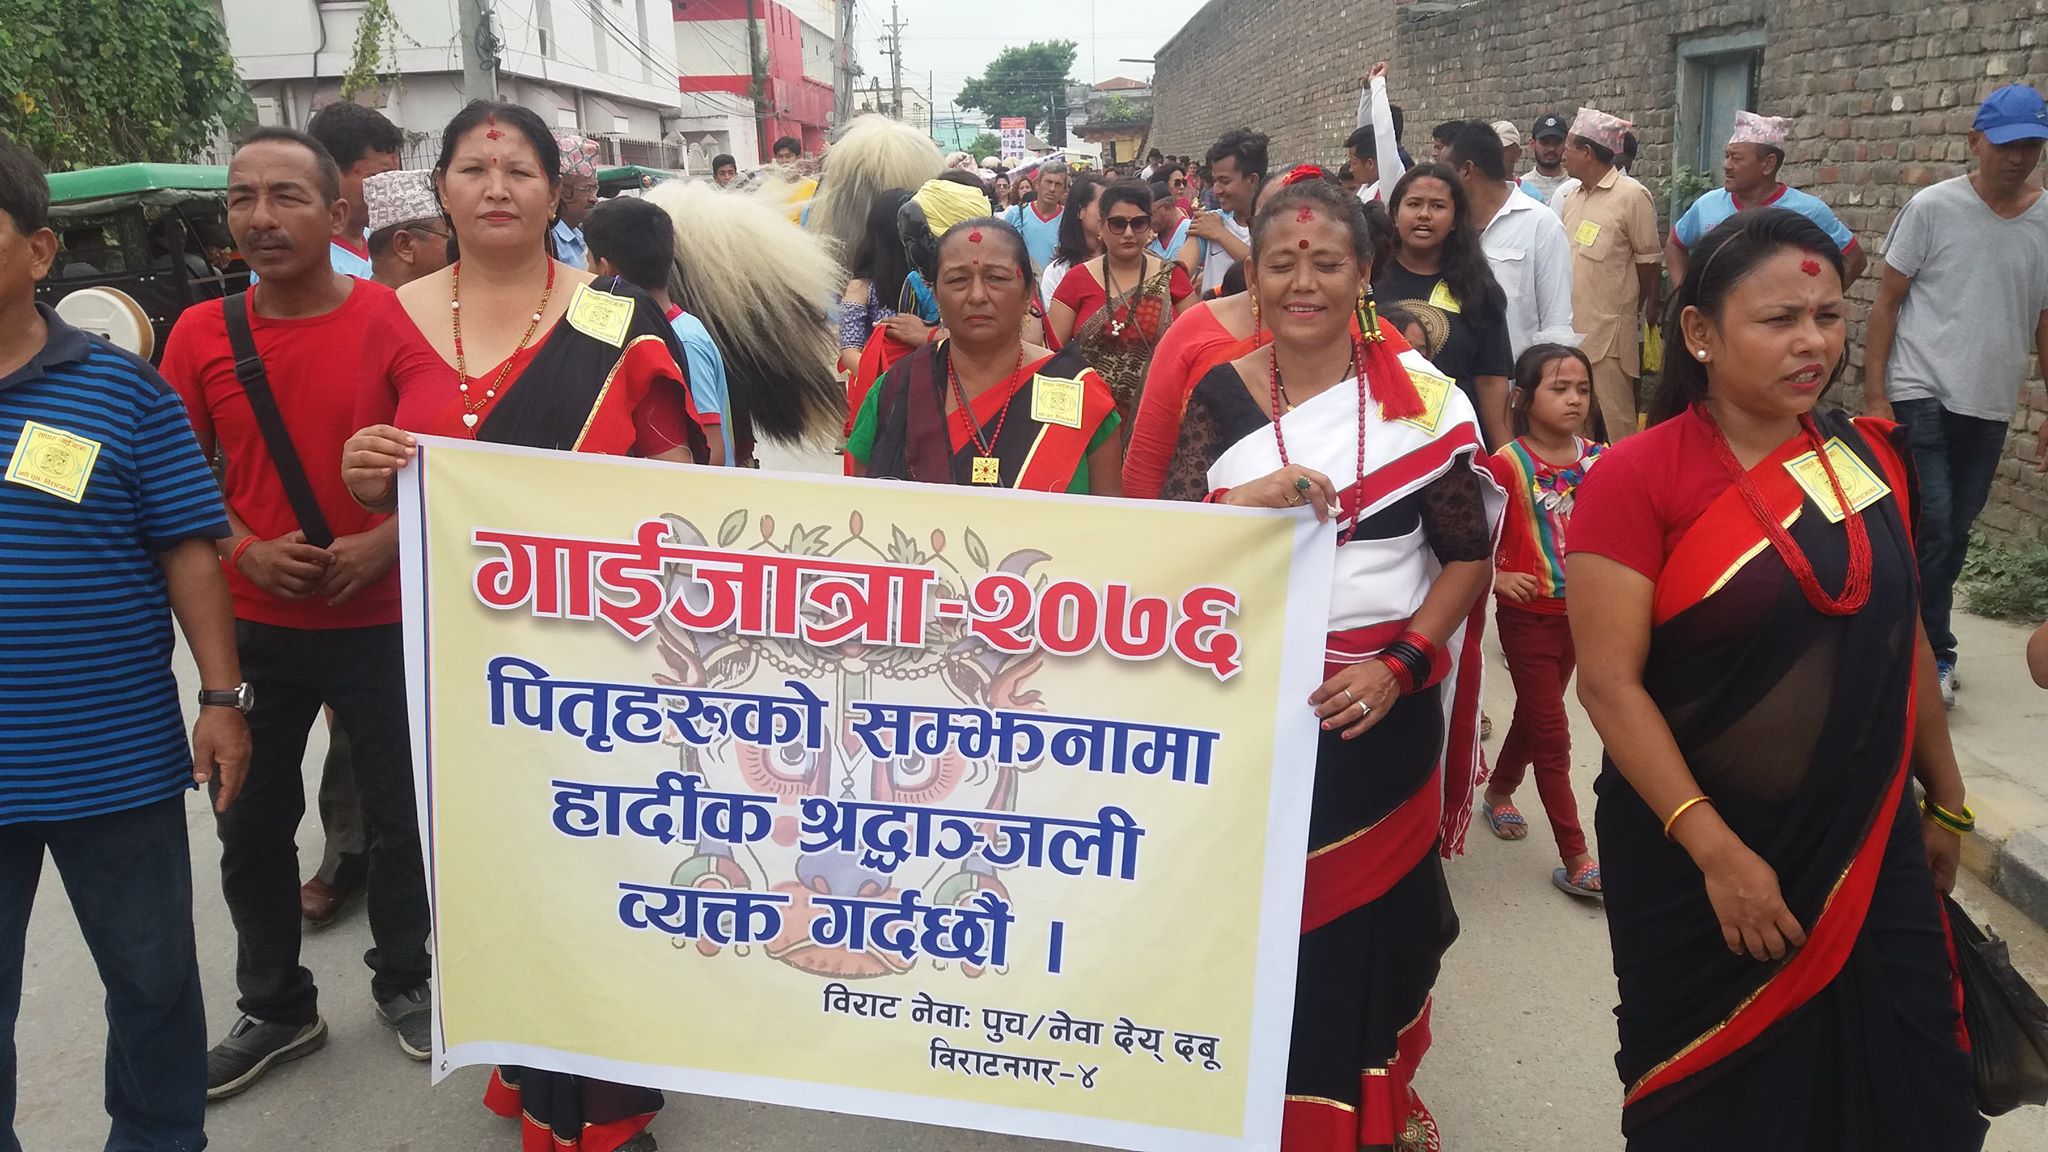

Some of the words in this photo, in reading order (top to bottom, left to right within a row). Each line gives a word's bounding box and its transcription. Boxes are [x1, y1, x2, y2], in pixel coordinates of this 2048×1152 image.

[474, 519, 1240, 678] गाईजात्रा-२०७६
[852, 702, 1220, 785] सम्झनामा
[552, 771, 778, 845] हार्दीक
[618, 882, 790, 945] व्यक्त
[823, 983, 902, 1019] विराट
[929, 1036, 1100, 1090] विराटनगर-४
